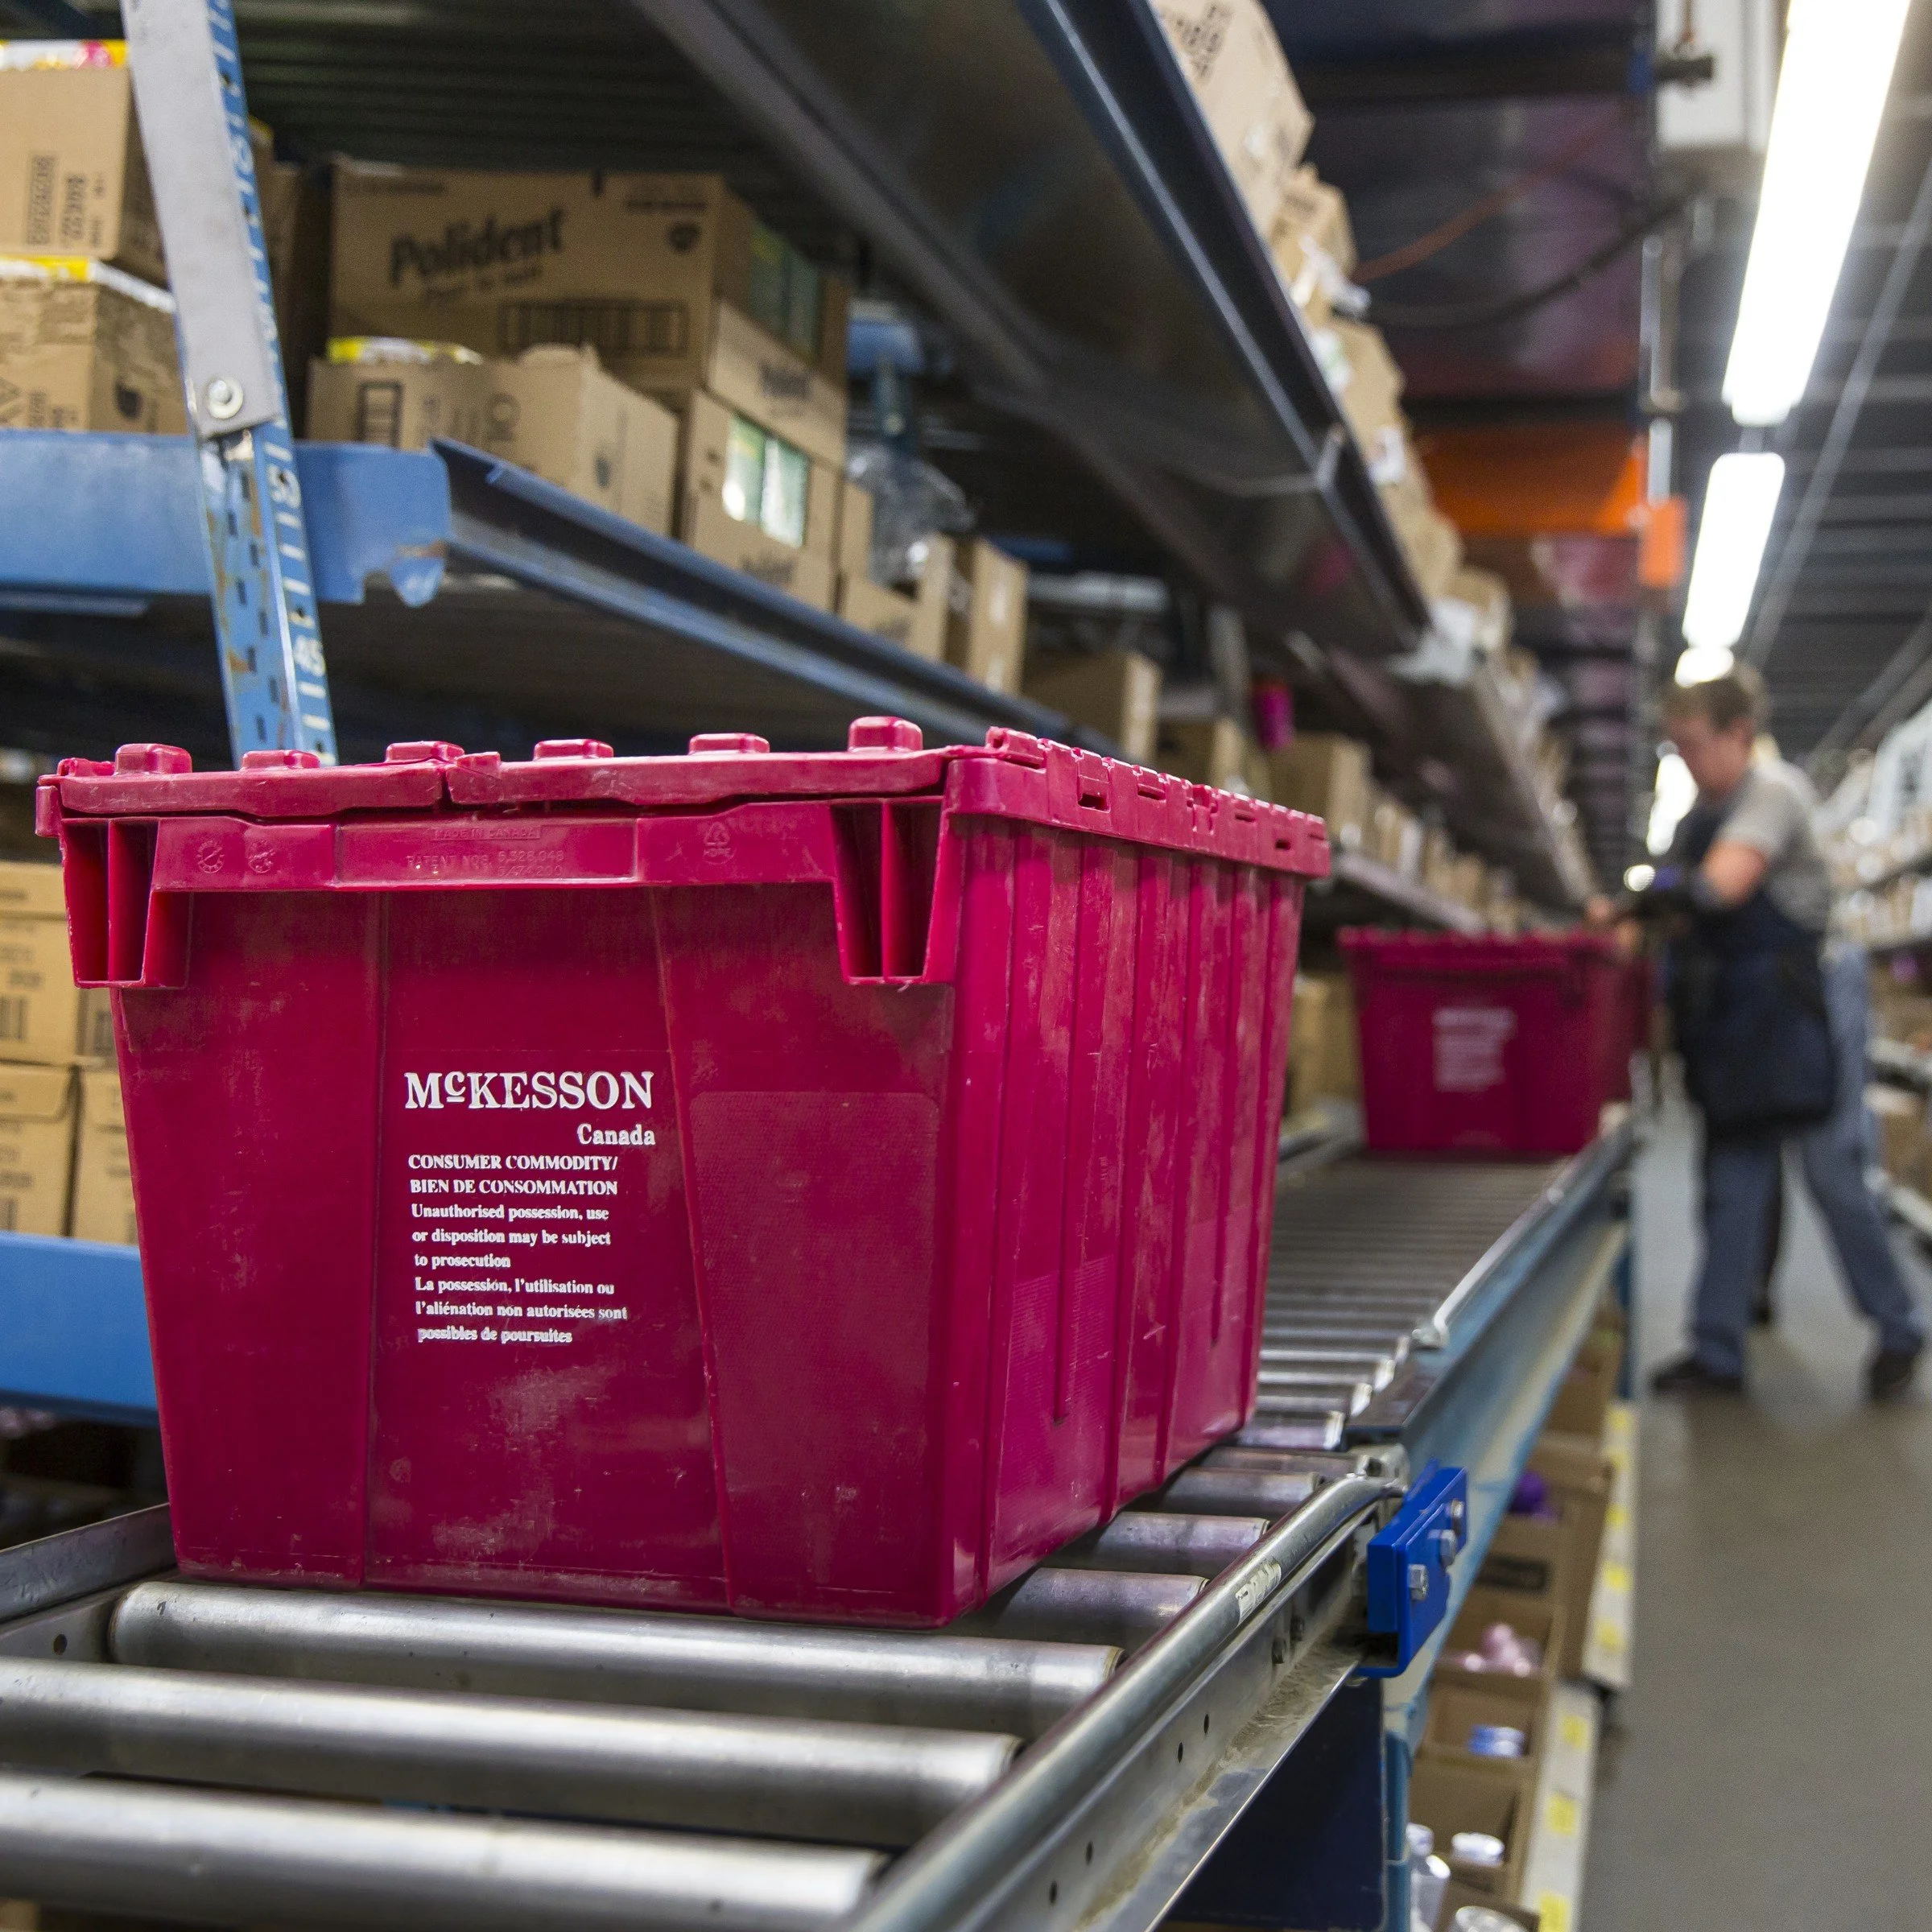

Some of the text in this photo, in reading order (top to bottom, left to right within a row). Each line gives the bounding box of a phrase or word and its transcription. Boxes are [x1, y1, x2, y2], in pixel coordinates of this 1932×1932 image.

[576, 1122, 656, 1146] Canada
[407, 1154, 618, 1171] CONSUMER COMMODITY/
[410, 1179, 618, 1195] BIEN DE CONSOMMATION
[411, 1203, 609, 1223] Unauthorised possession, use
[411, 1228, 612, 1248] or disposition may be subject
[414, 1253, 511, 1270] to prosecution
[415, 1276, 435, 1291] La
[437, 1278, 513, 1294] possession,
[597, 1283, 615, 1295] ou
[496, 1304, 523, 1320] non
[597, 1307, 628, 1322] sont
[480, 1326, 498, 1341] de
[500, 1327, 573, 1344] poursuites
